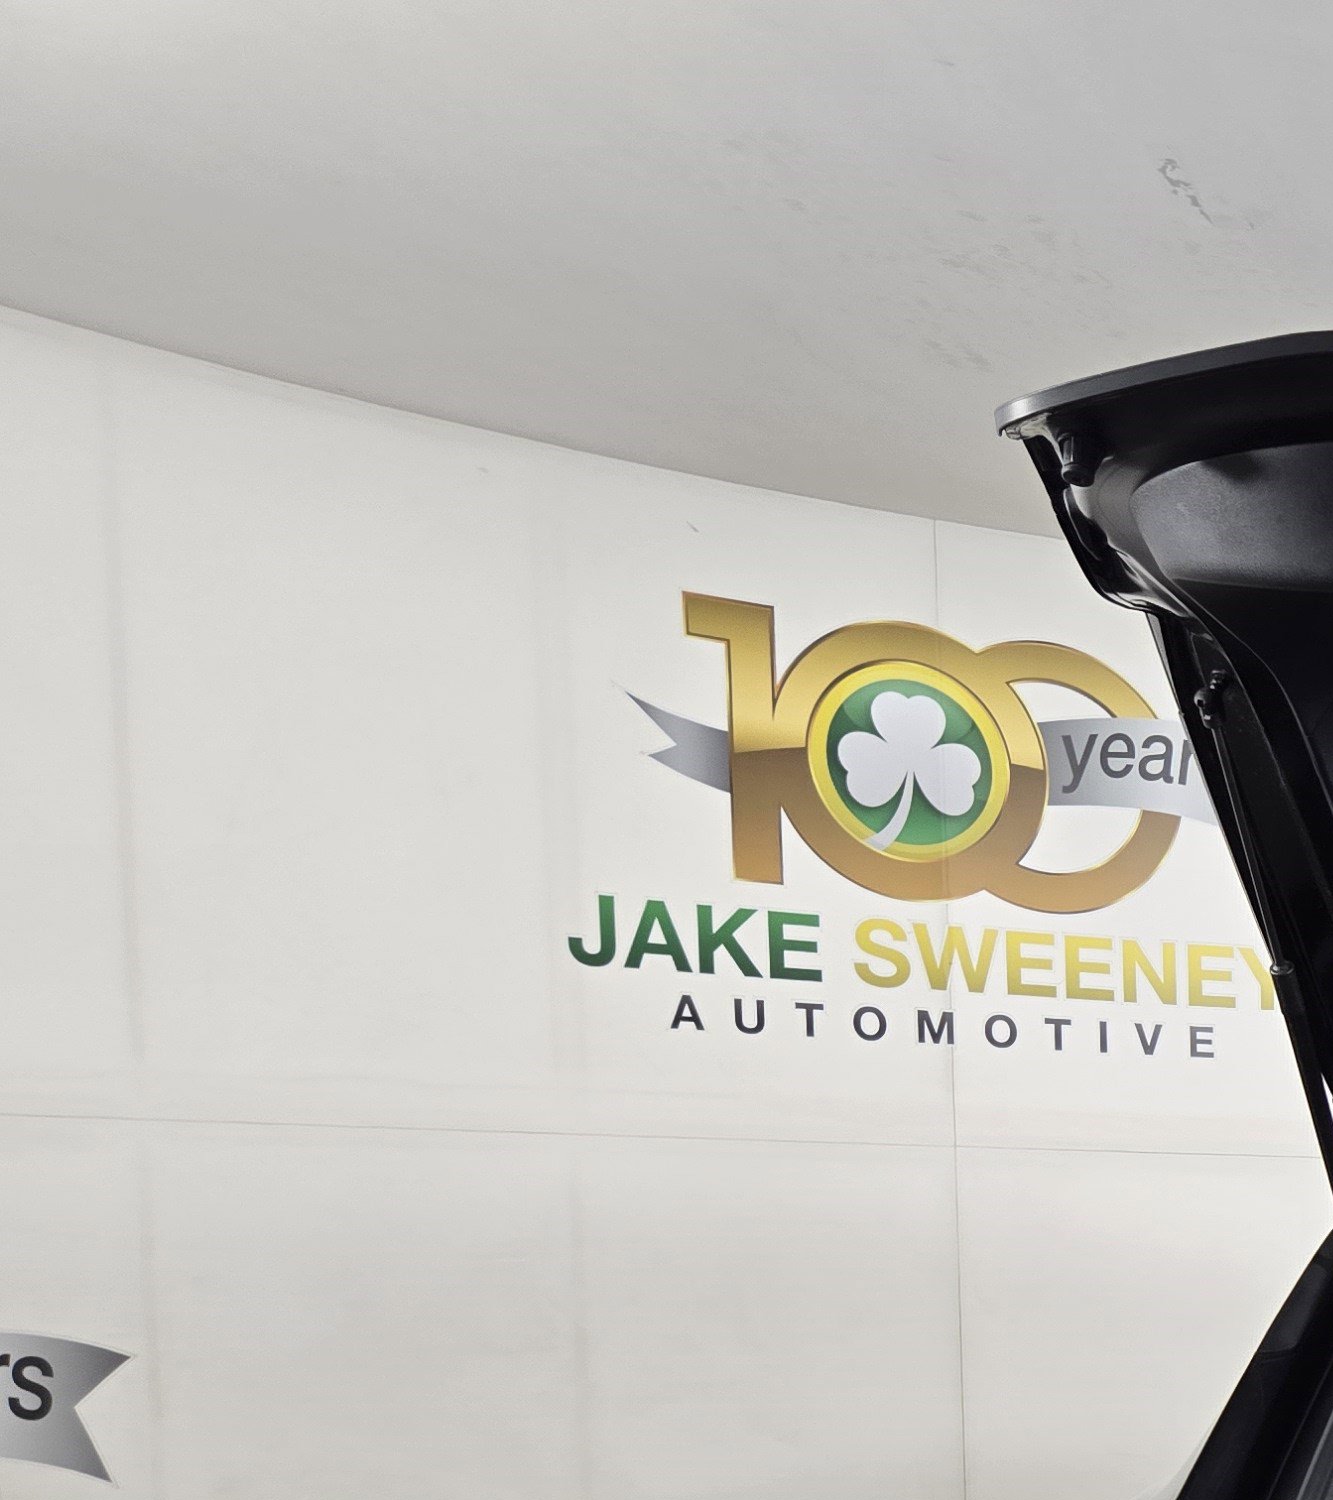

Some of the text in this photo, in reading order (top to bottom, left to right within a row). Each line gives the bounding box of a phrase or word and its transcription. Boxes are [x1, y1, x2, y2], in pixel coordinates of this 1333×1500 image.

[682, 591, 1196, 914] 100 year
[568, 895, 1275, 1011] JAKE SWEENEY
[670, 994, 1215, 1058] AUTOMOTIVE
